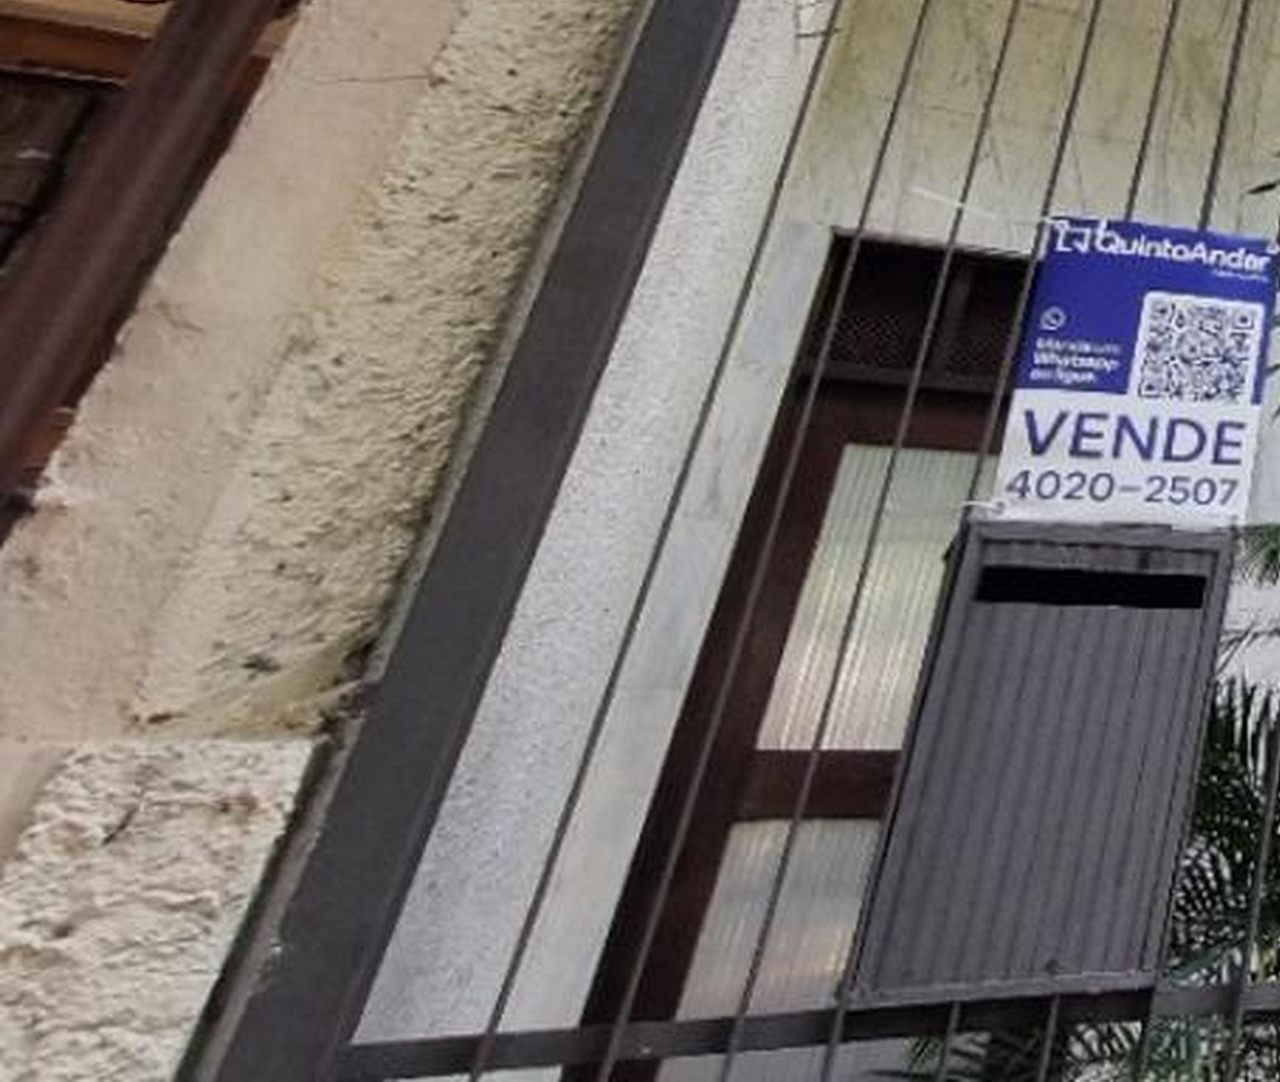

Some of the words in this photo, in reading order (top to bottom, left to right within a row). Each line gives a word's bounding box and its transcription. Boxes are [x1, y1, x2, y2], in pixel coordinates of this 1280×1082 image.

[1095, 225, 1270, 273] QuintoAndar
[1024, 409, 1247, 466] VENDE
[1005, 469, 1240, 506] 4020-2507
